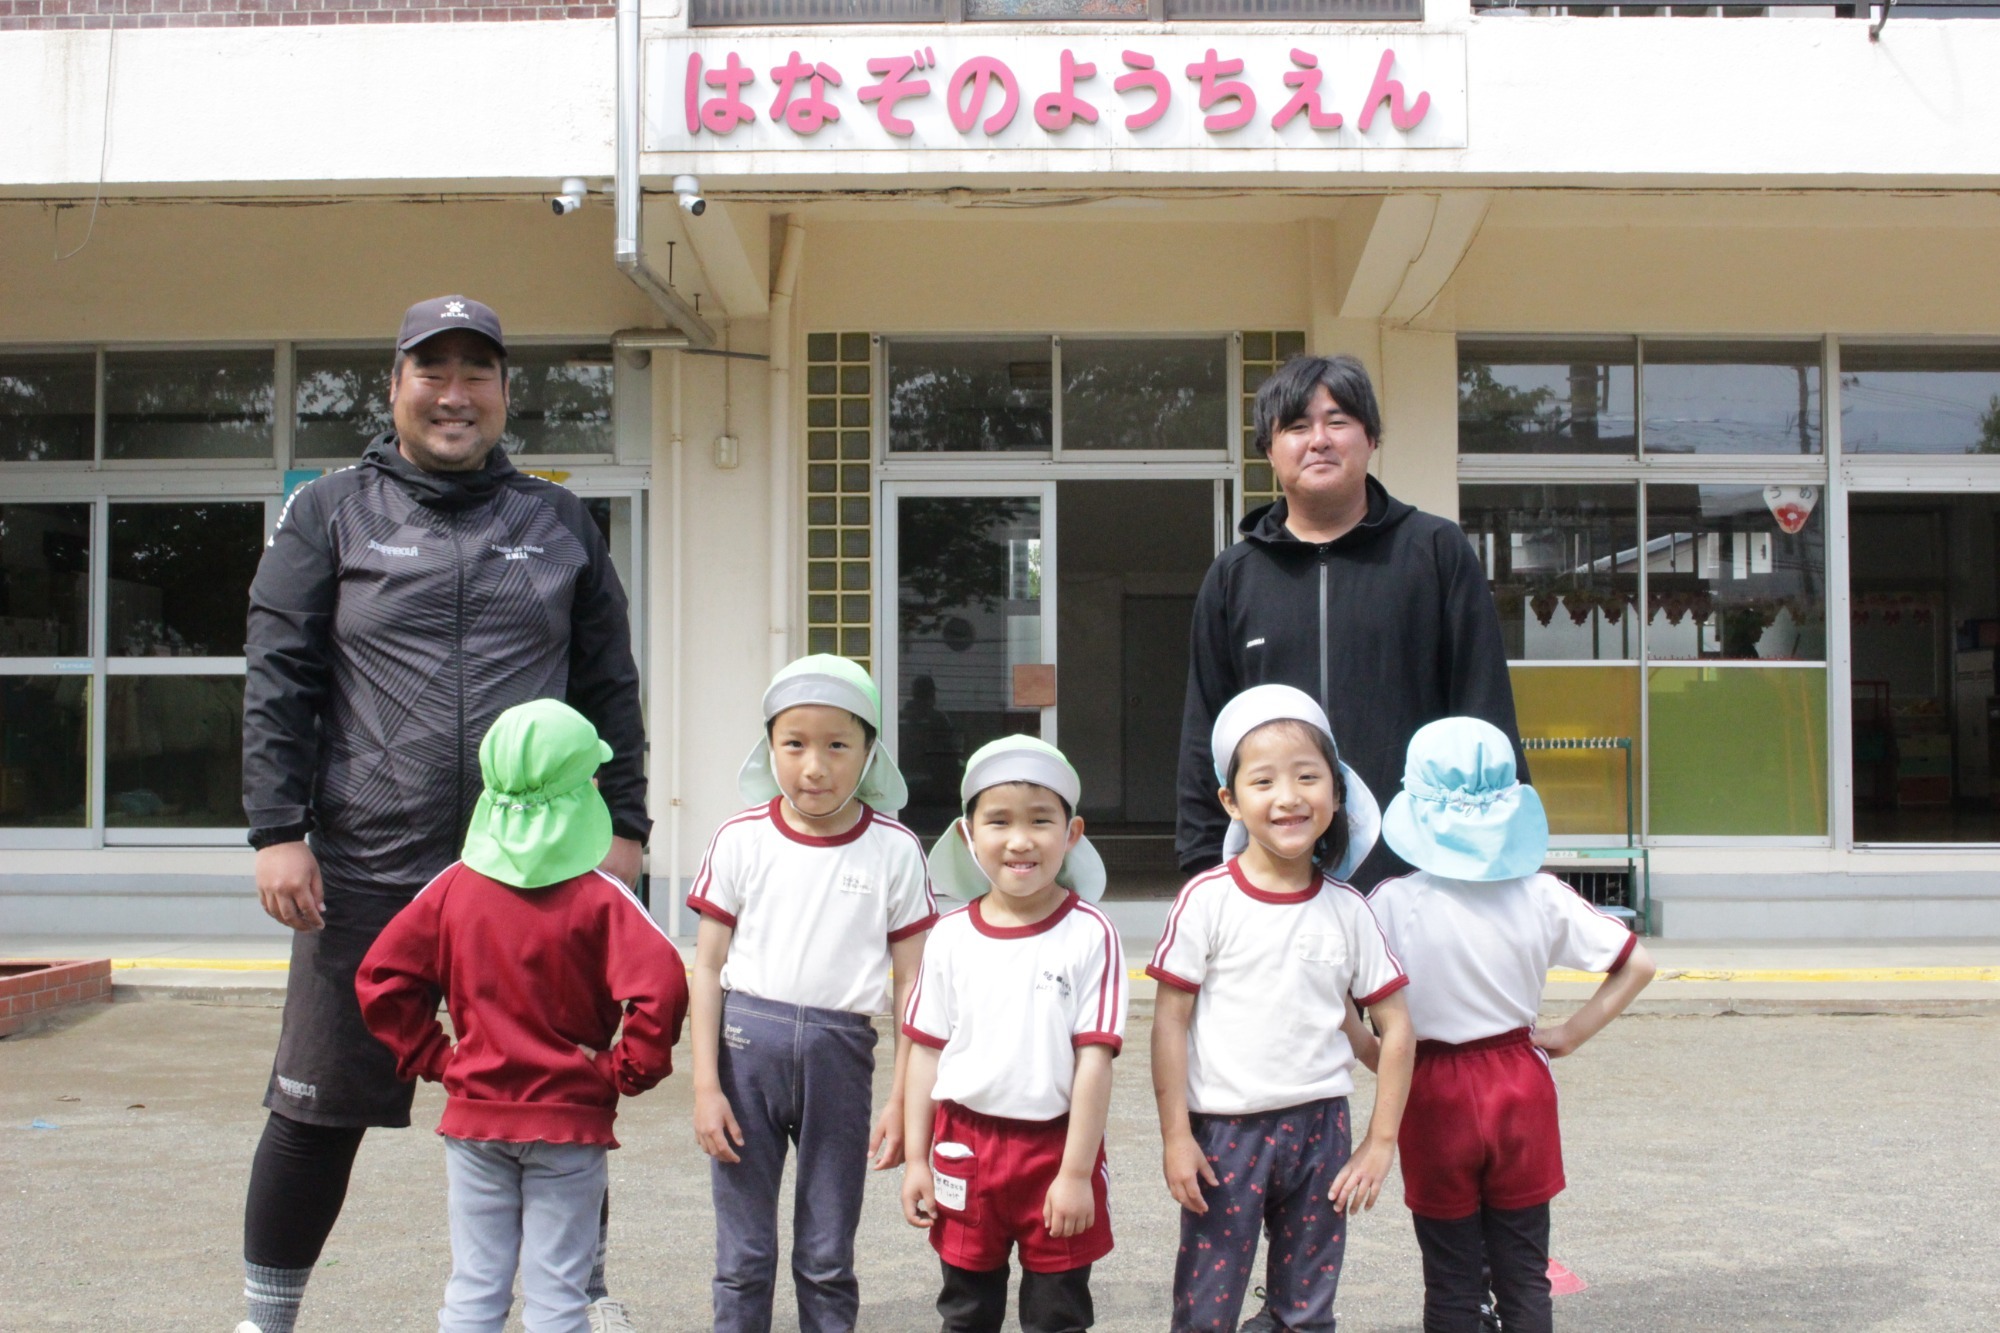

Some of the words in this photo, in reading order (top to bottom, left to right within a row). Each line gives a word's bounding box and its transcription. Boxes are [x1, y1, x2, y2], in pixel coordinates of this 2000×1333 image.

[686, 47, 1429, 134] はなぞのようちえん
